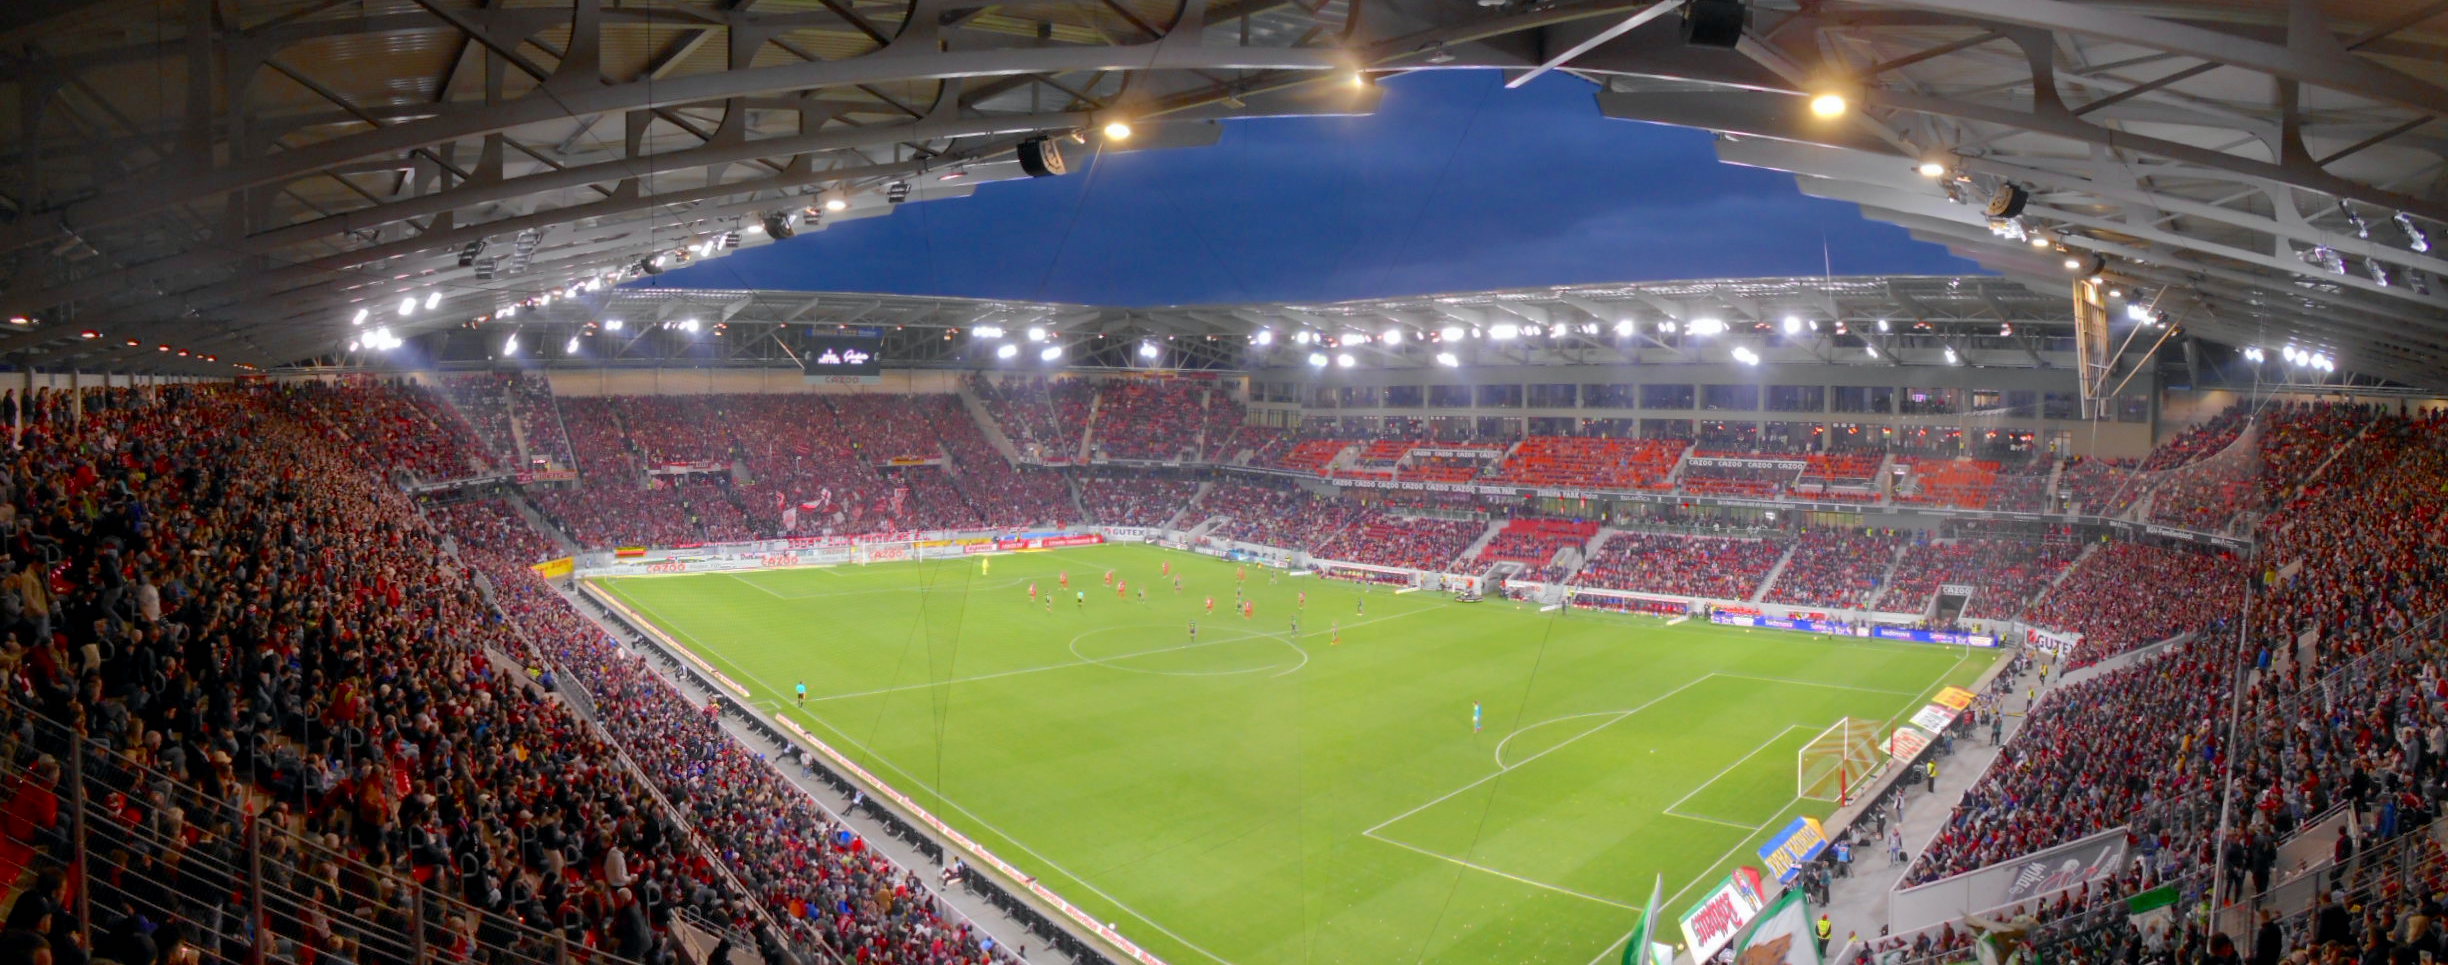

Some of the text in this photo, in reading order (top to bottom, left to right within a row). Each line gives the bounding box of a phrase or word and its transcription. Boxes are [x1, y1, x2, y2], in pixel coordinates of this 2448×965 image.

[1112, 527, 1144, 537] GUTEX
[761, 554, 799, 568] CAZOO
[647, 561, 686, 573] CAZOO
[1942, 586, 1970, 595] CAZOO
